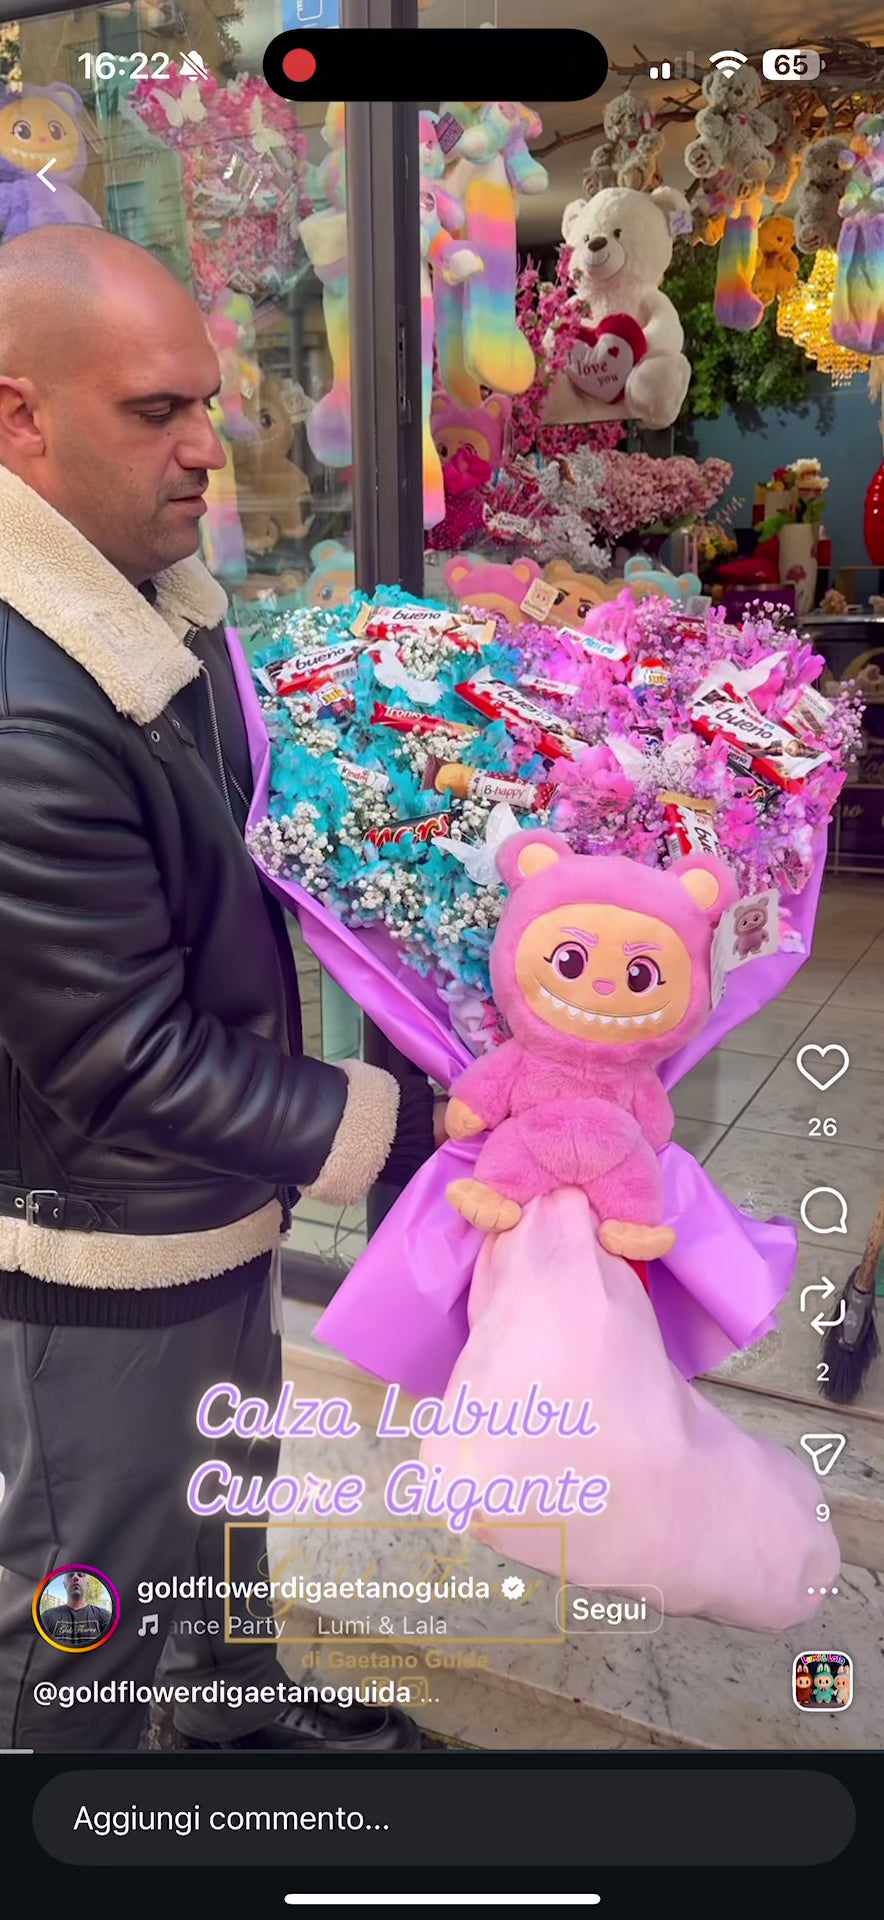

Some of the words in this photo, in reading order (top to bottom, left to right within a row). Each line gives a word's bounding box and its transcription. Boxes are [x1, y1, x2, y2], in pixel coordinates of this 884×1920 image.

[576, 361, 608, 377] love
[597, 374, 619, 387] you
[391, 609, 442, 621] bueno
[295, 647, 346, 671] bueno
[715, 707, 773, 740] bueno
